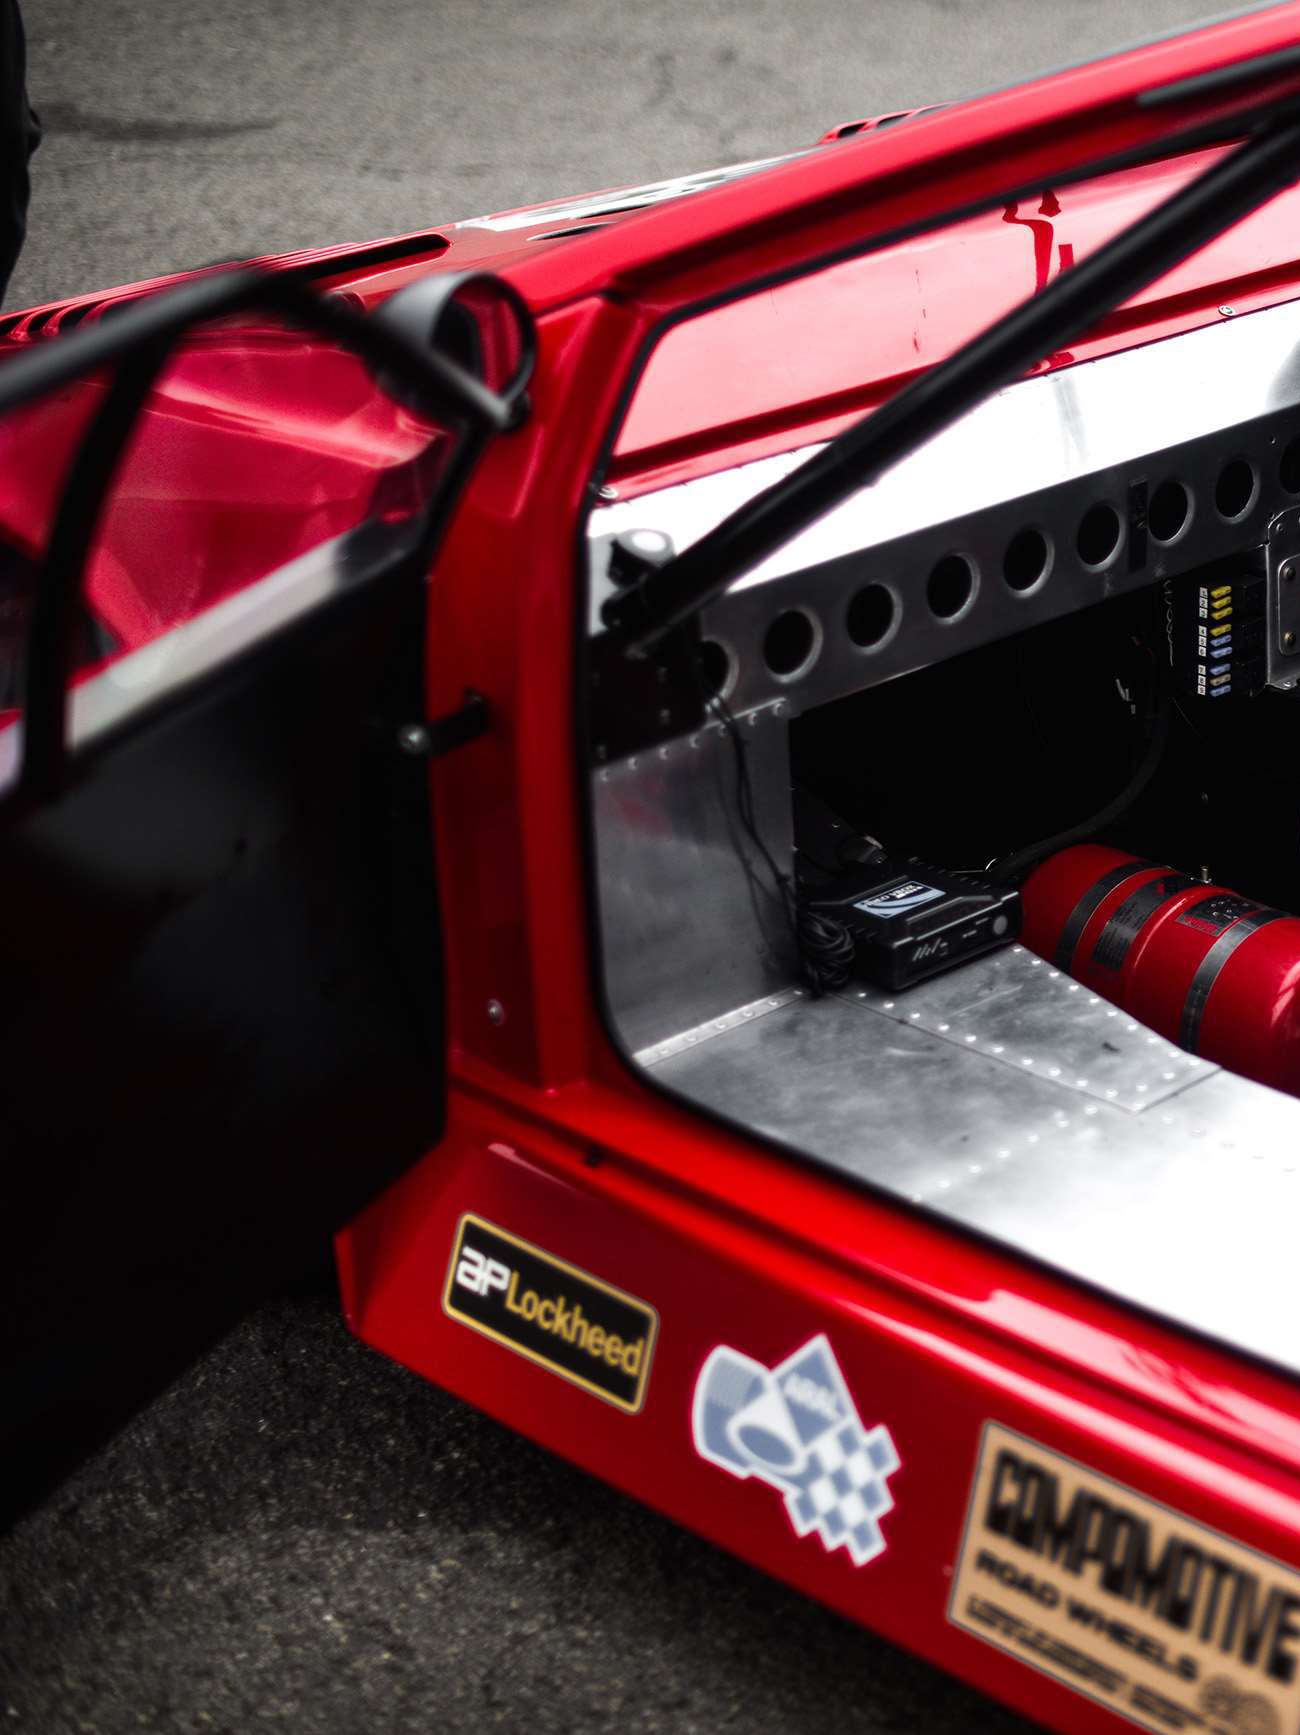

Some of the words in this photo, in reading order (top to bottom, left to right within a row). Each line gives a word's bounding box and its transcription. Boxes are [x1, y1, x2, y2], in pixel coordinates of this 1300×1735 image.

[506, 1270, 645, 1376] Lockheed
[975, 1549, 1061, 1611] ROAD
[1066, 1598, 1198, 1682] WHEELS
